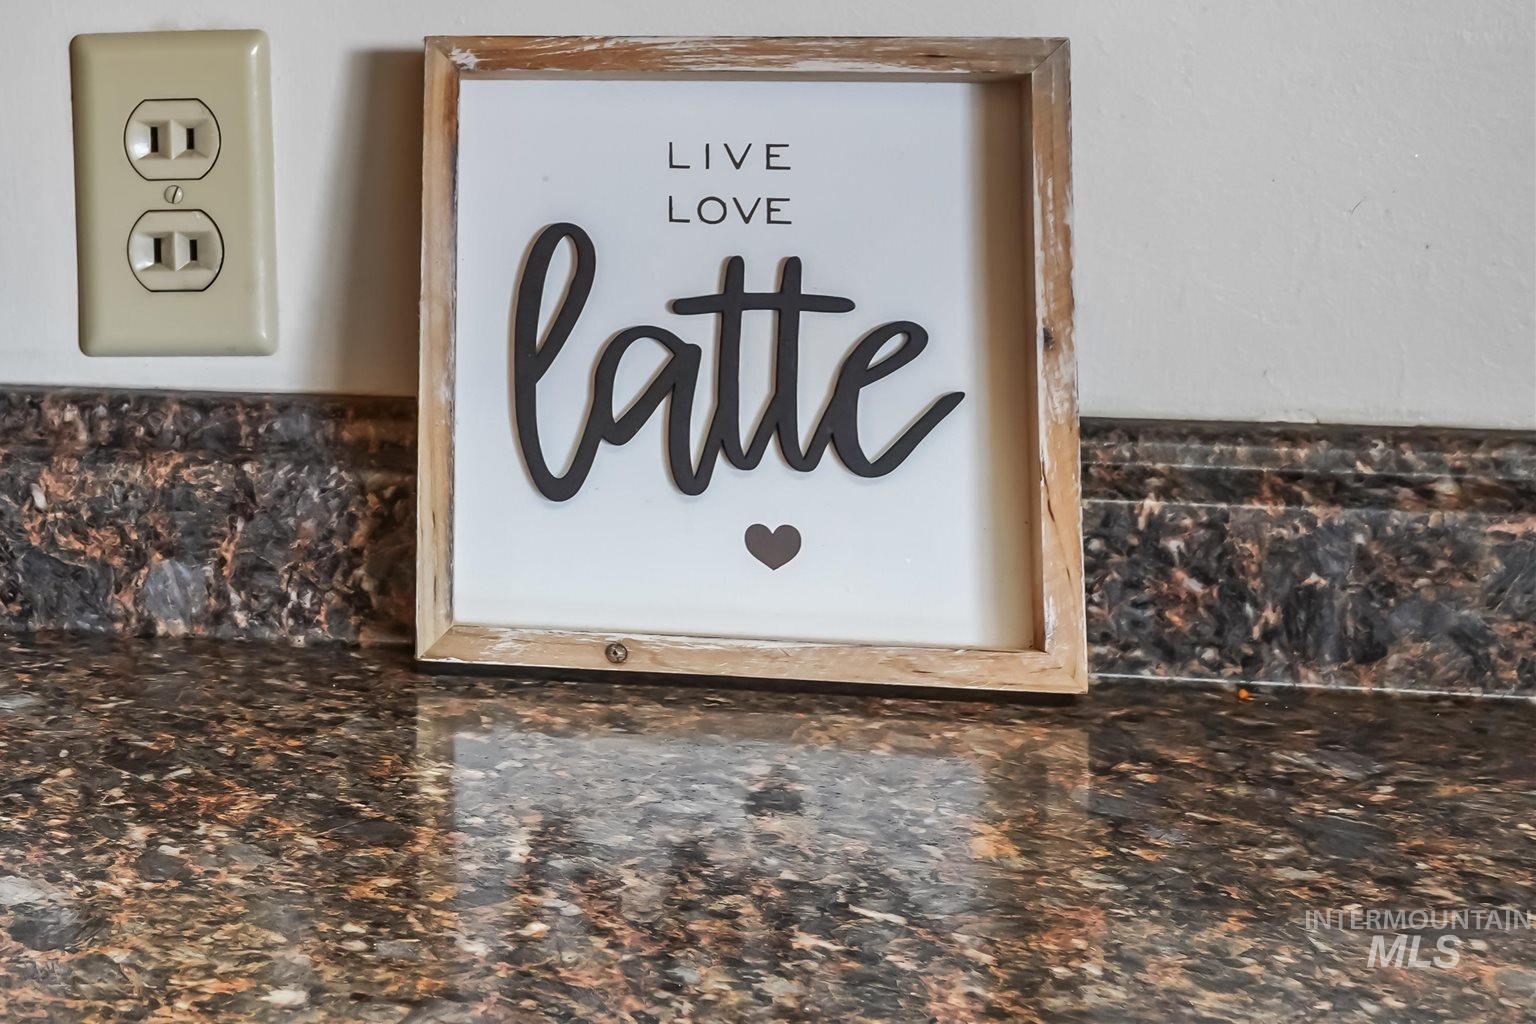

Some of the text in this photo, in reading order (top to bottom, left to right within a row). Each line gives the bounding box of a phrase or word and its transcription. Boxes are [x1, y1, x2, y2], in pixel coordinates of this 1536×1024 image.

[668, 141, 792, 171] LIVE
[668, 195, 793, 225] LOVE
[512, 221, 966, 502] latte
